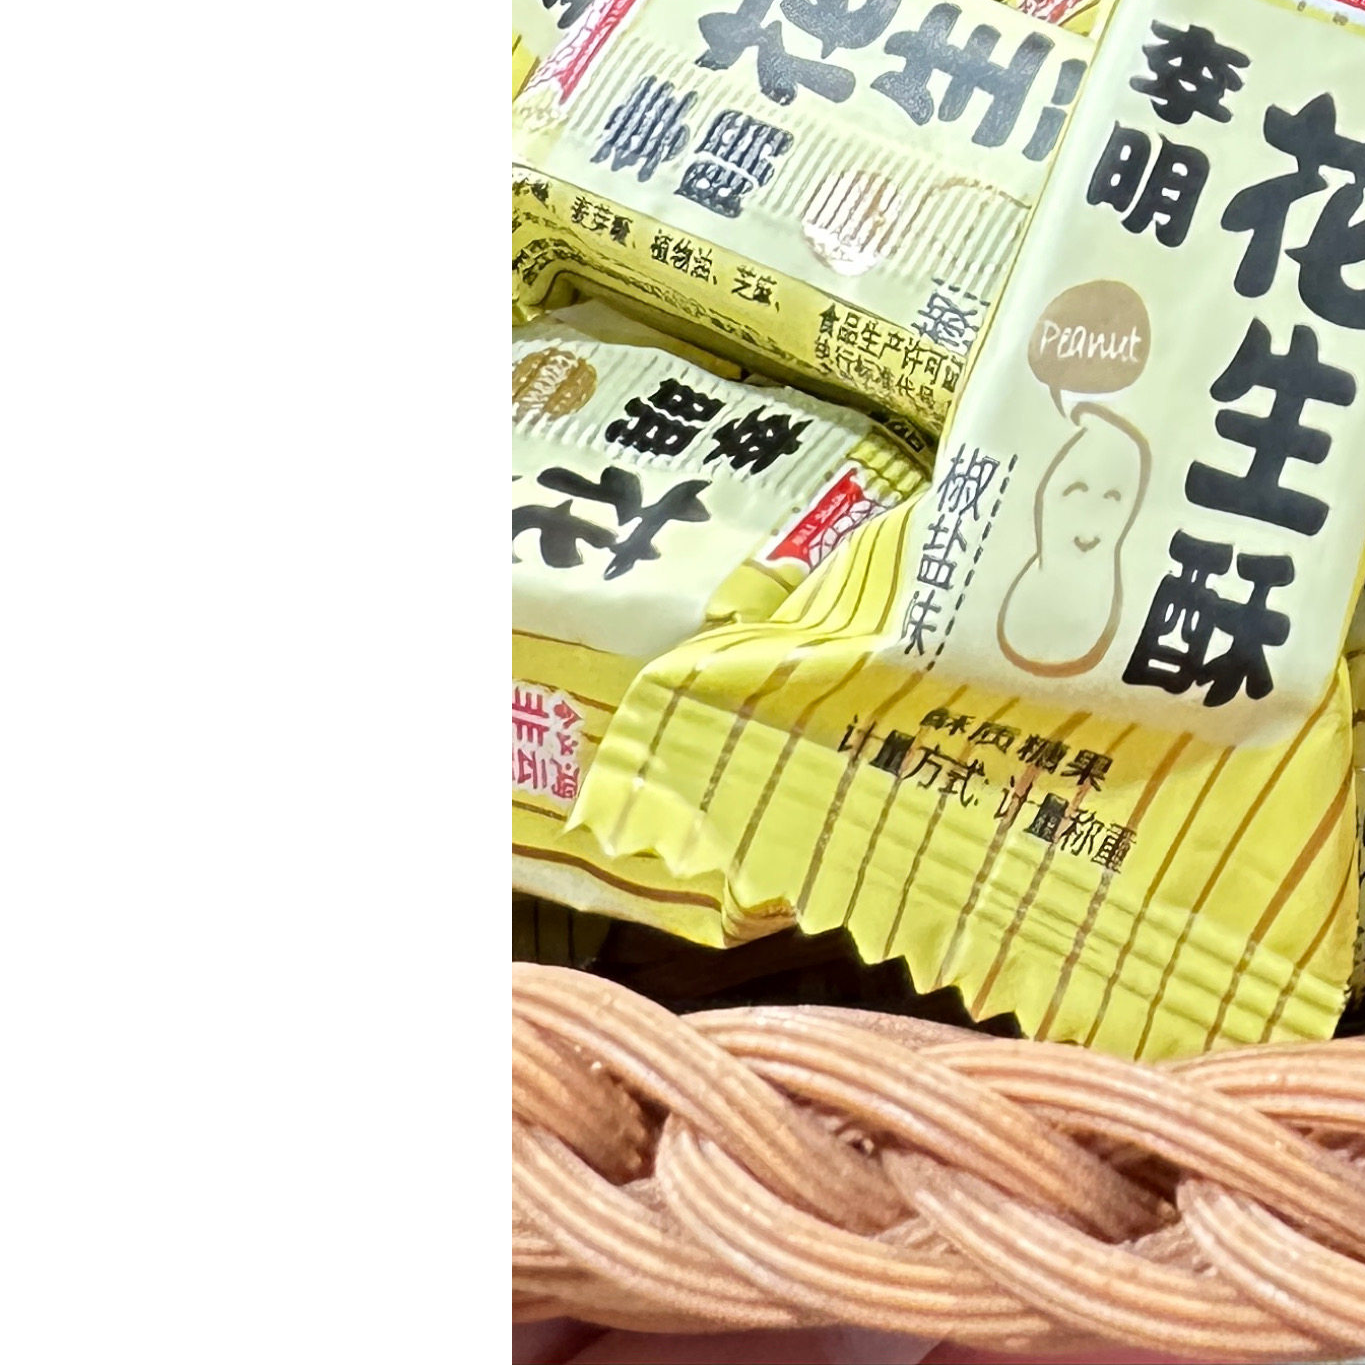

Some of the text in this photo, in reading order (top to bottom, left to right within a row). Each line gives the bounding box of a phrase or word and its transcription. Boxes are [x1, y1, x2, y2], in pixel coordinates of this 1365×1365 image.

[1085, 19, 1253, 249] 李明
[1038, 316, 1145, 366] Peanut
[899, 442, 1003, 659] 椒盐味
[918, 707, 1114, 794] 酥质糖果
